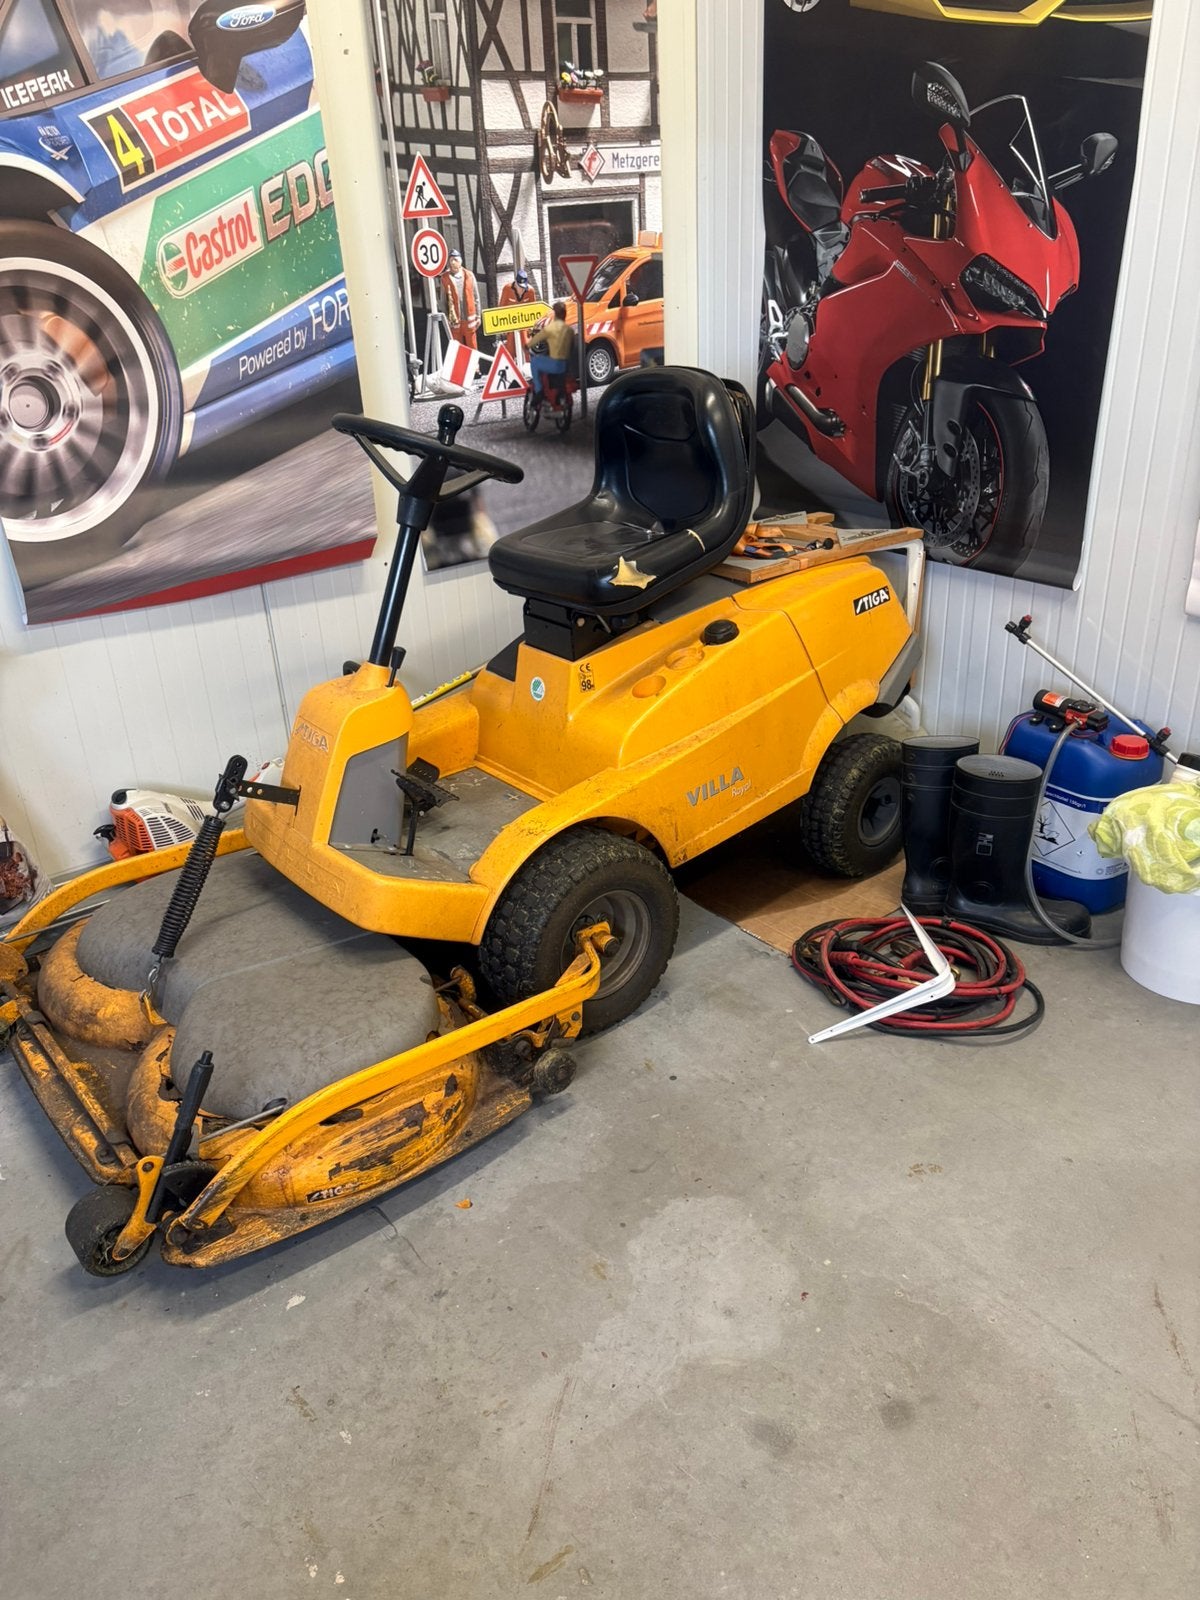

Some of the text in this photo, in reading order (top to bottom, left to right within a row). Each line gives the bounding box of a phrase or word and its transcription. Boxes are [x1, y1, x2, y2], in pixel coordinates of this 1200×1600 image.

[230, 11, 265, 27] Ford
[1, 69, 75, 108] ICEPEAK
[106, 114, 147, 176] 4
[612, 152, 660, 170] Metzgere
[185, 200, 258, 279] Castrol
[419, 243, 439, 266] 30
[239, 331, 292, 380] Powered
[294, 327, 308, 350] by
[686, 766, 744, 807] VILLA
[309, 1182, 361, 1203] STIG
